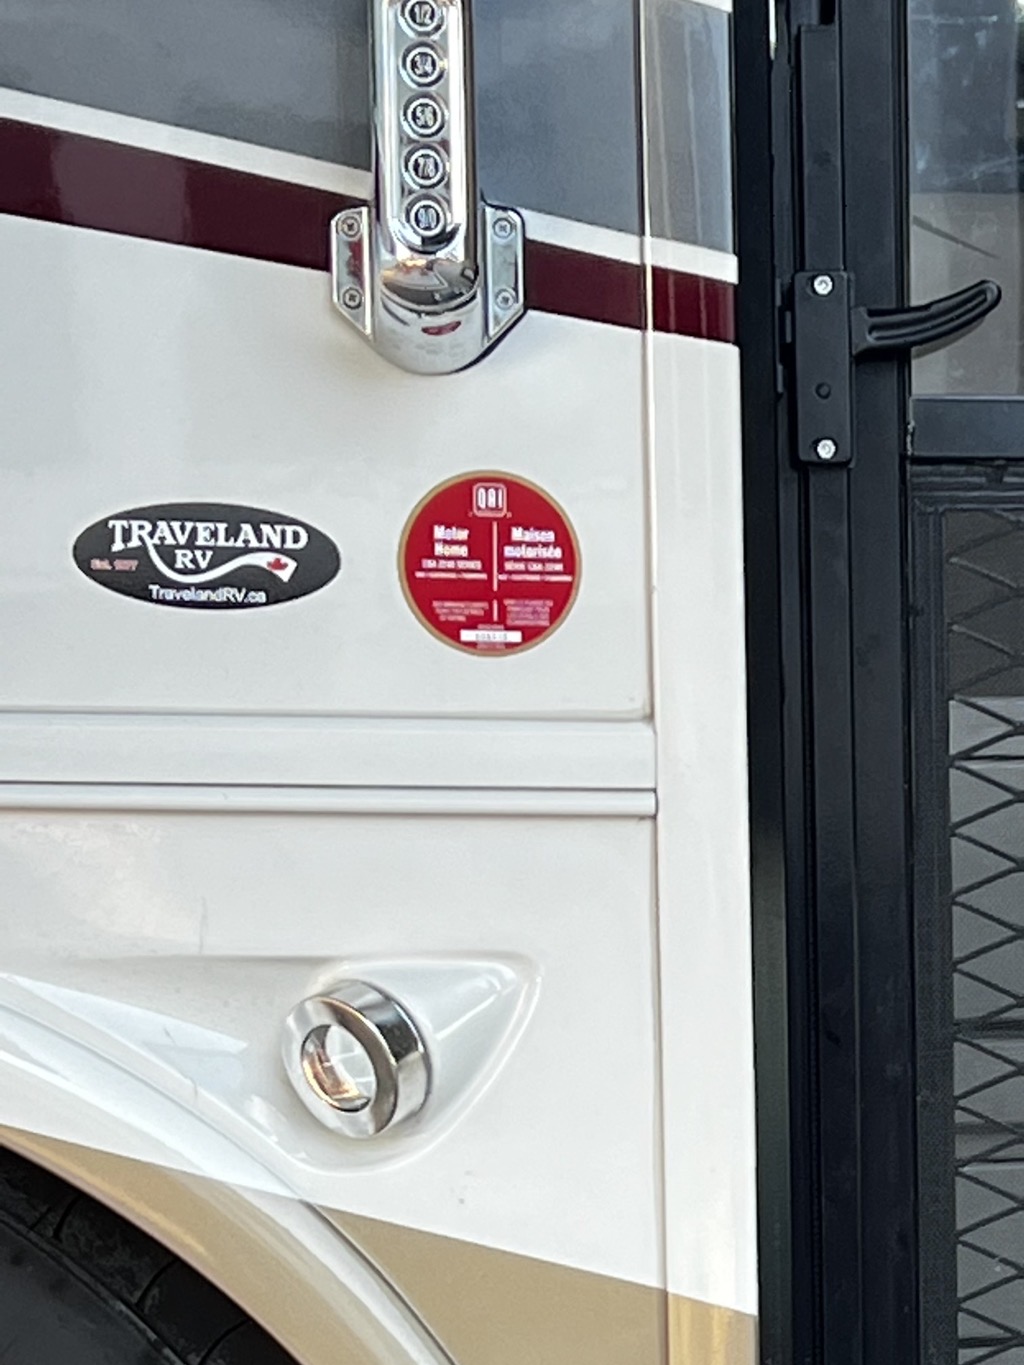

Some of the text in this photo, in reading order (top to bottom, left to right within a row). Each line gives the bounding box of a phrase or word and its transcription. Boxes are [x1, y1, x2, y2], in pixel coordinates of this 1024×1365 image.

[107, 519, 309, 552] TRAVELAND
[433, 524, 470, 541] Motor
[510, 526, 556, 543] Maison
[434, 541, 470, 557] Home
[174, 550, 213, 570] RV
[148, 584, 267, 603] TravelandRV.ca
